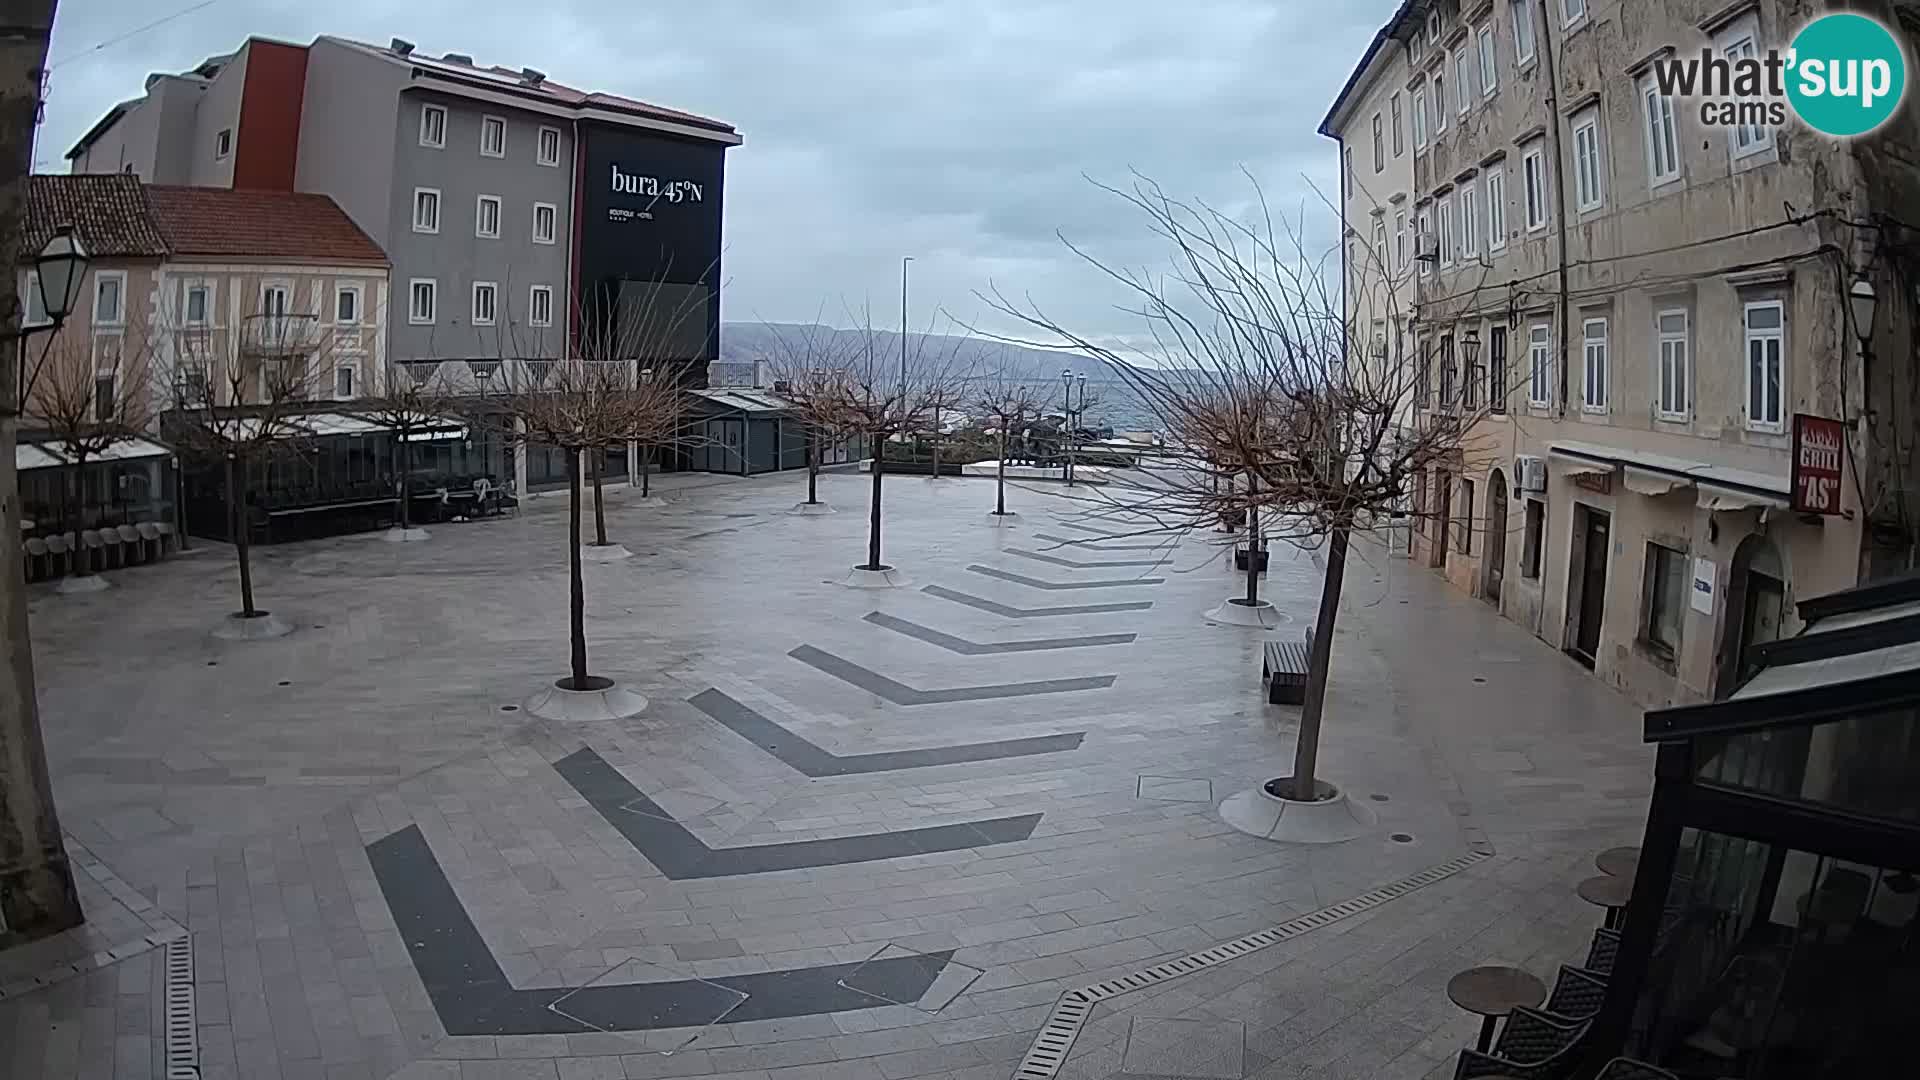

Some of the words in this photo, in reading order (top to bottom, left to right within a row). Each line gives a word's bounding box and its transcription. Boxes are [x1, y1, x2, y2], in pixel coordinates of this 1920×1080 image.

[611, 165, 659, 196] bura
[609, 209, 635, 218] BOUTIQUE
[637, 212, 653, 220] HOTEL
[1800, 447, 1840, 472] GRILL
